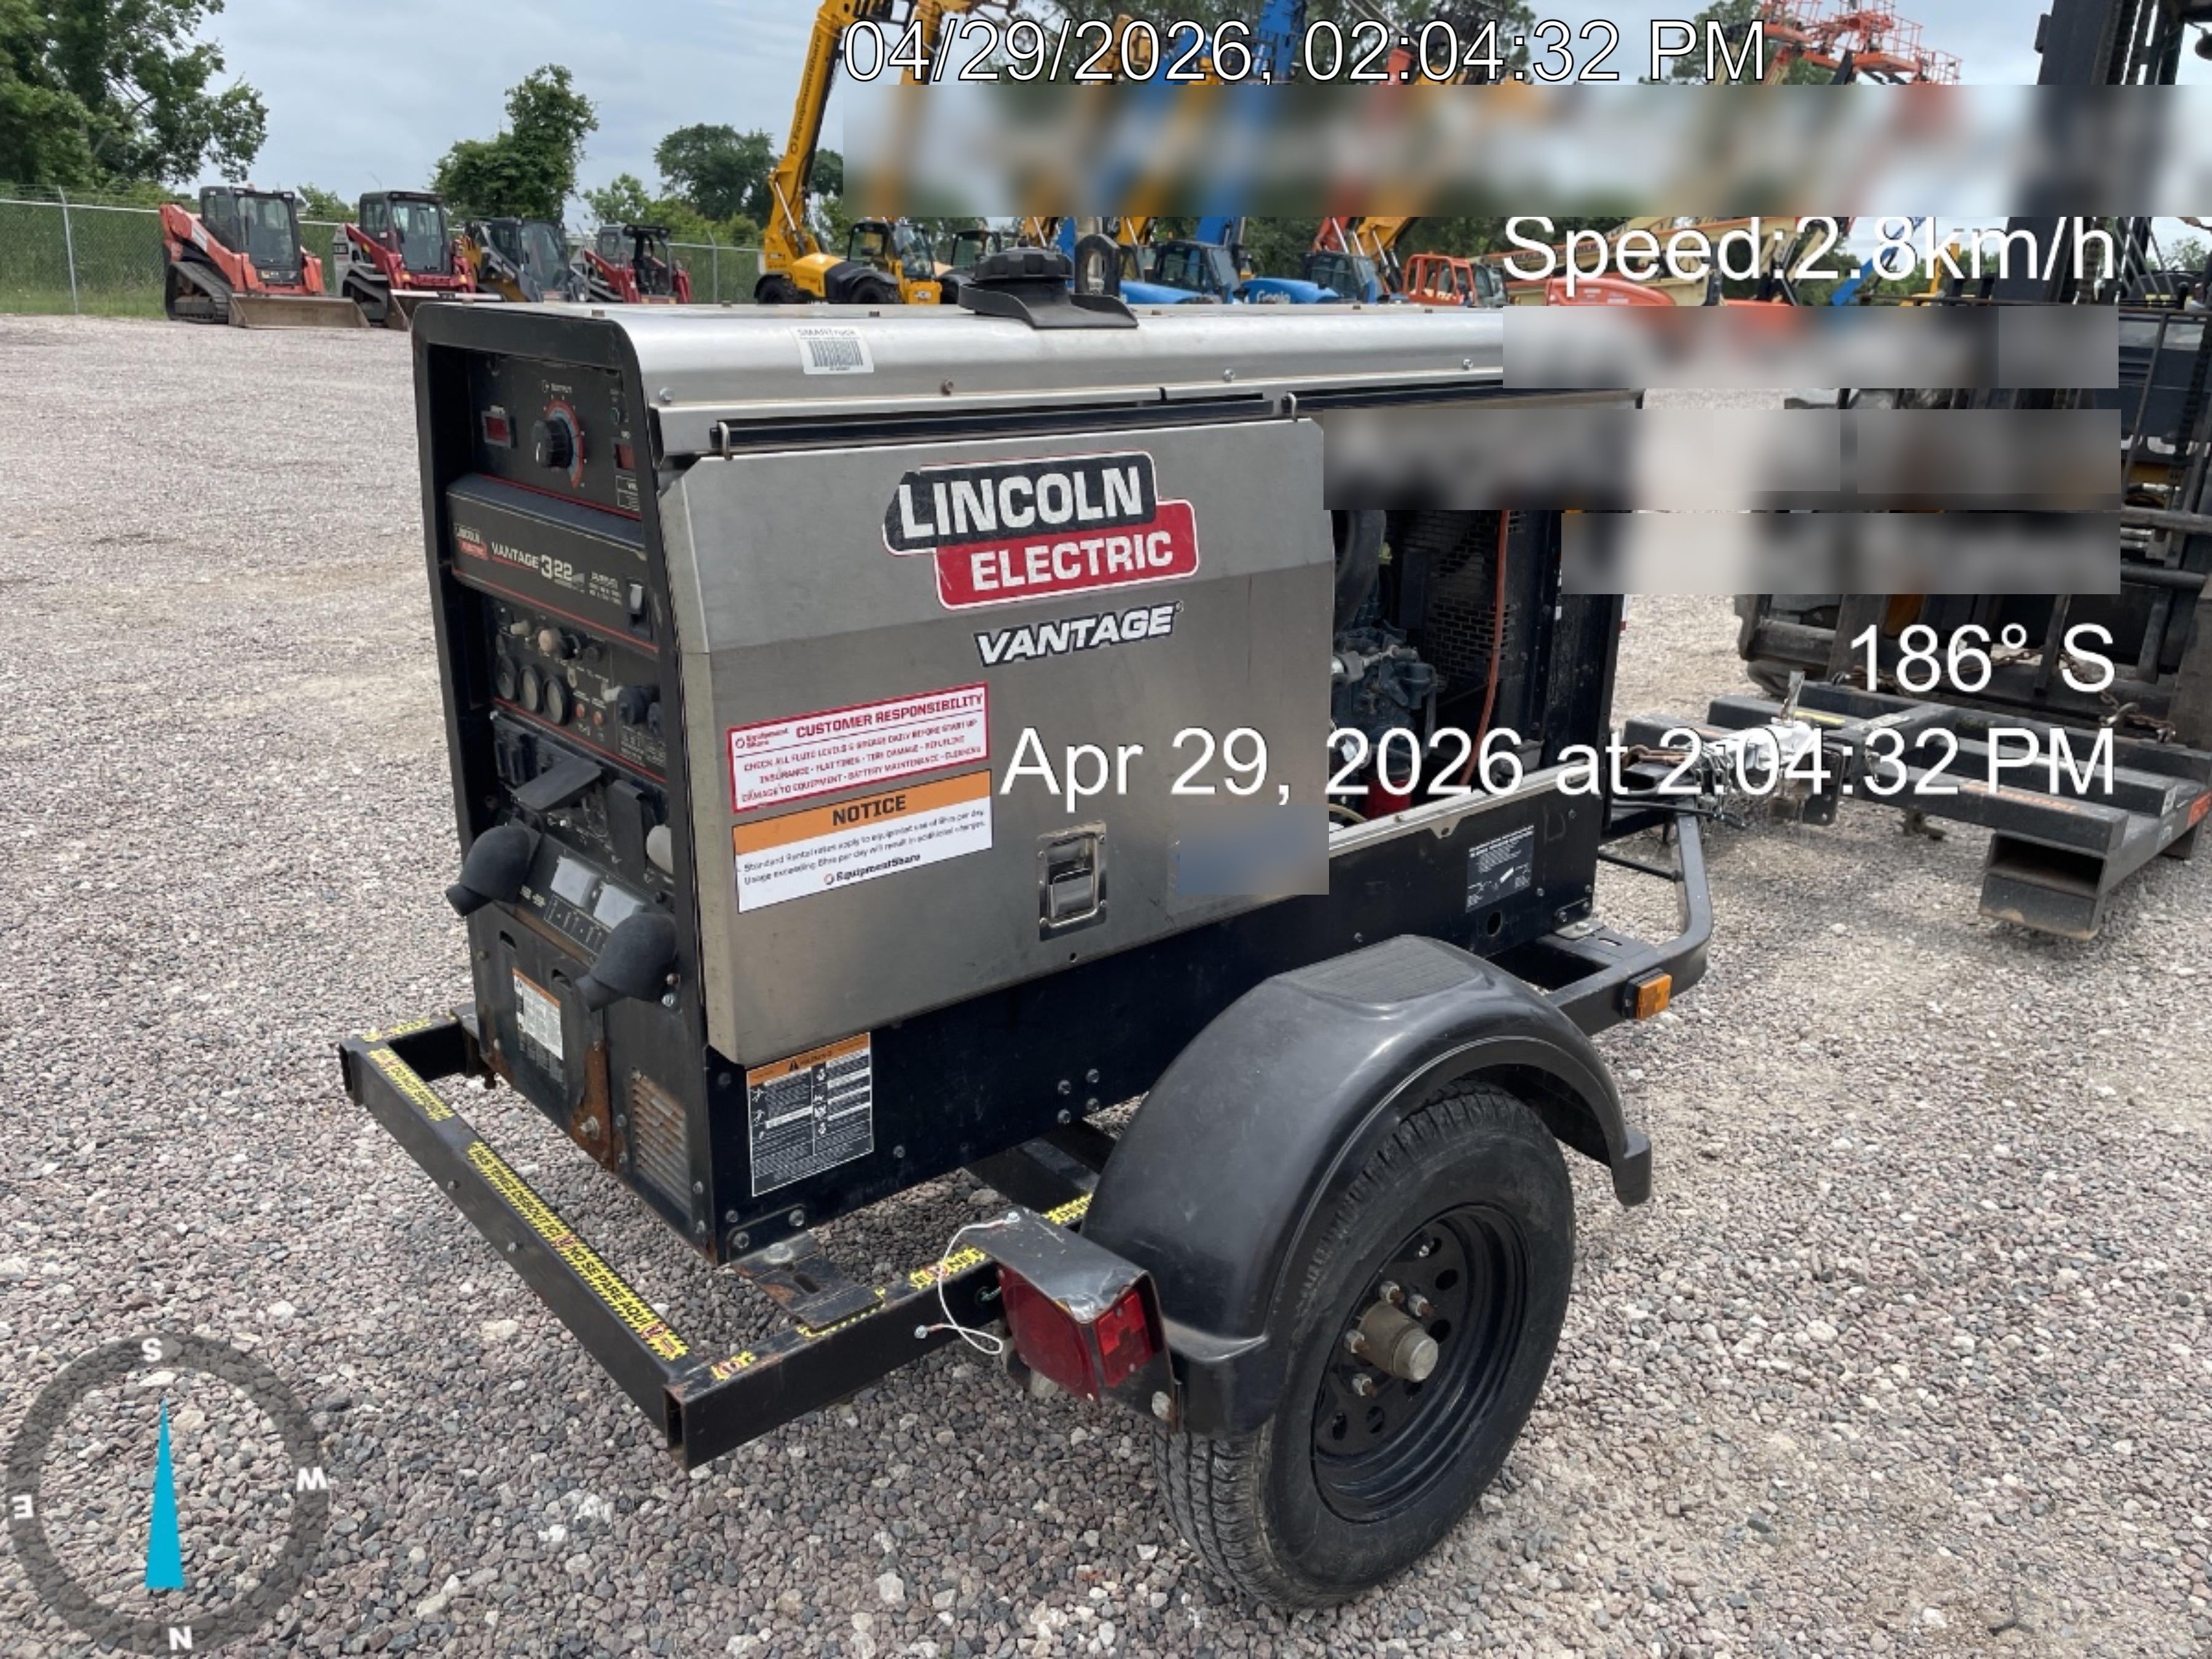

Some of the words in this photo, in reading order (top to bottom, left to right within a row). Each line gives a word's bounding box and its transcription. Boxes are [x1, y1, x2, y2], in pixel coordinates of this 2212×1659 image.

[899, 466, 1143, 539] LINCOLN
[492, 541, 539, 569] VANTAGE
[541, 555, 573, 579] 322
[970, 530, 1173, 592] ELECTRIC
[796, 715, 872, 737] CUSTOMER
[876, 694, 983, 723] RESPONSIBILITY
[833, 794, 906, 826] NOTICE
[836, 854, 920, 880] EquipmentShare
[570, 1246, 586, 1261] NO
[584, 1261, 601, 1276] SE
[598, 1275, 627, 1301] PARE
[620, 1300, 649, 1326] AQUI
